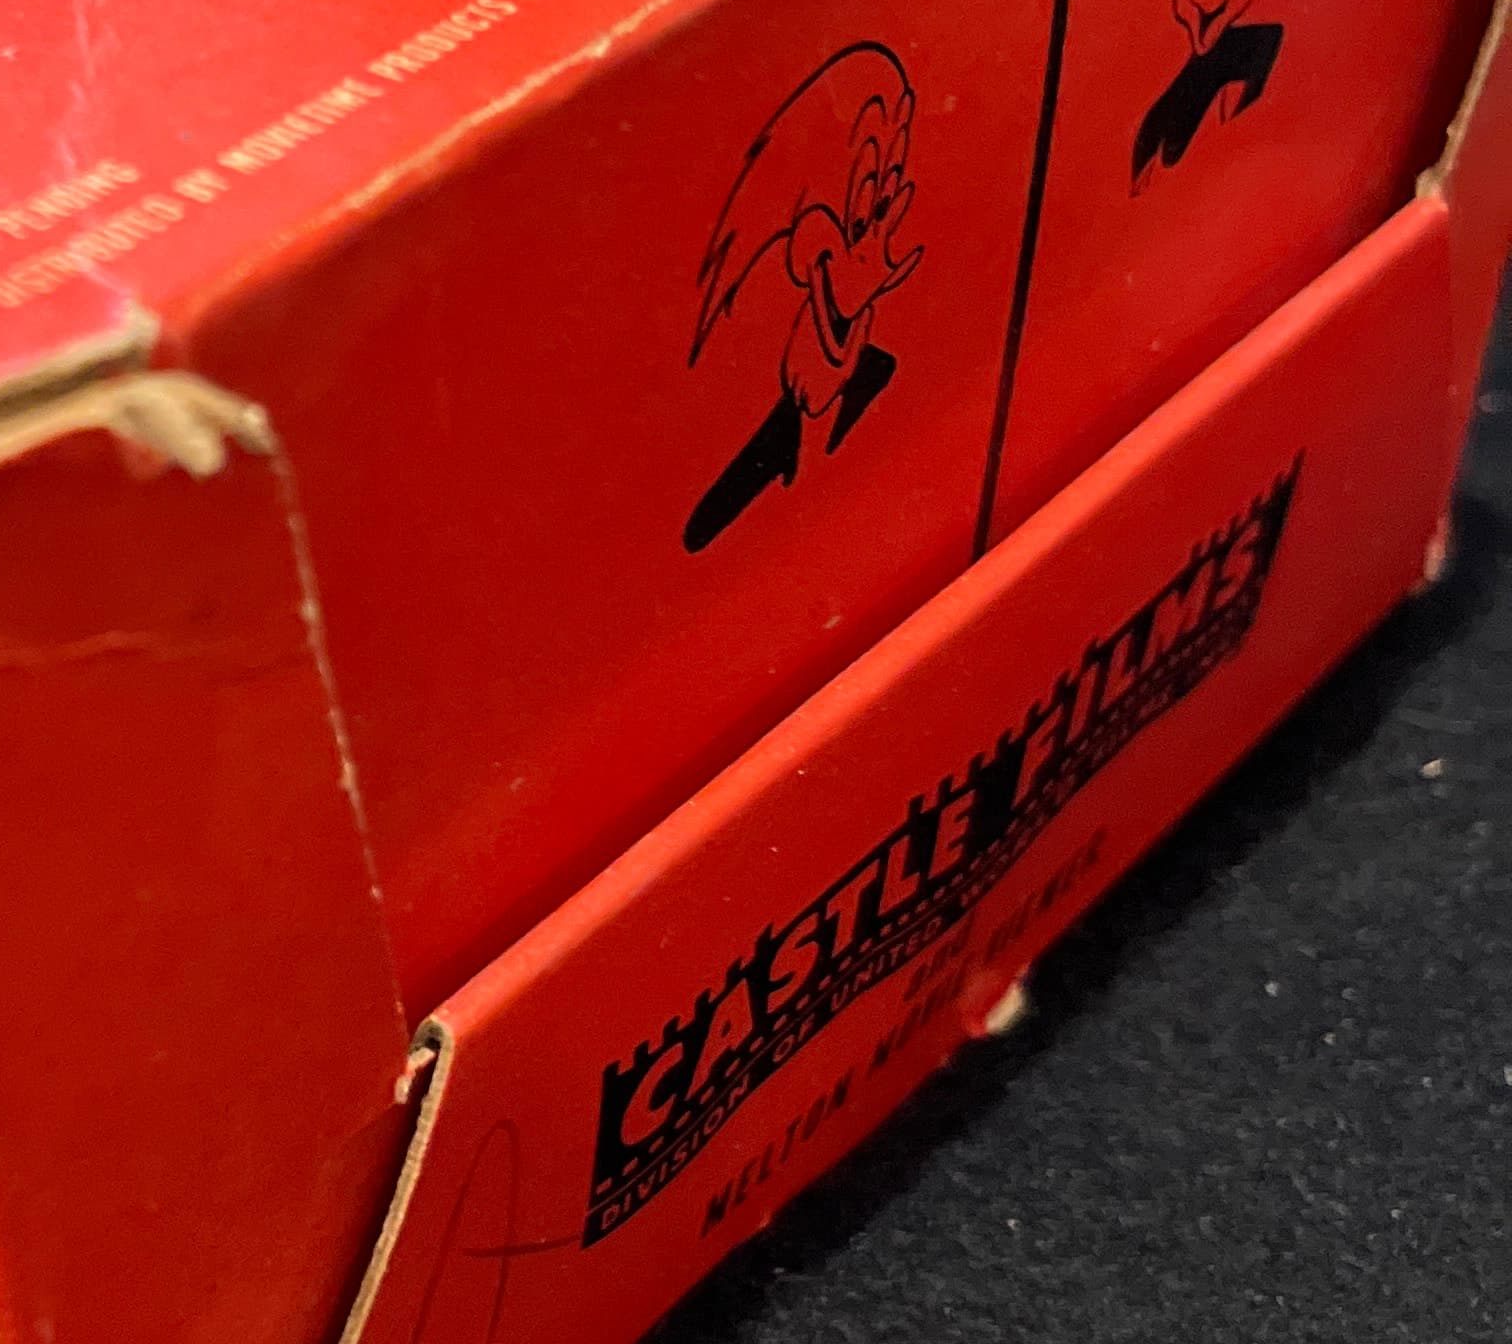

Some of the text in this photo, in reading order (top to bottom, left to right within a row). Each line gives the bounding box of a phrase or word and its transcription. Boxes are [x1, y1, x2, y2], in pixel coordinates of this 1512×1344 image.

[619, 518, 1262, 1148] CASTLE FILMS
[599, 1074, 751, 1231] DIVISION
[772, 1012, 817, 1063] OF
[829, 917, 943, 1013] UNITED
[700, 1066, 856, 1238] MELTON
